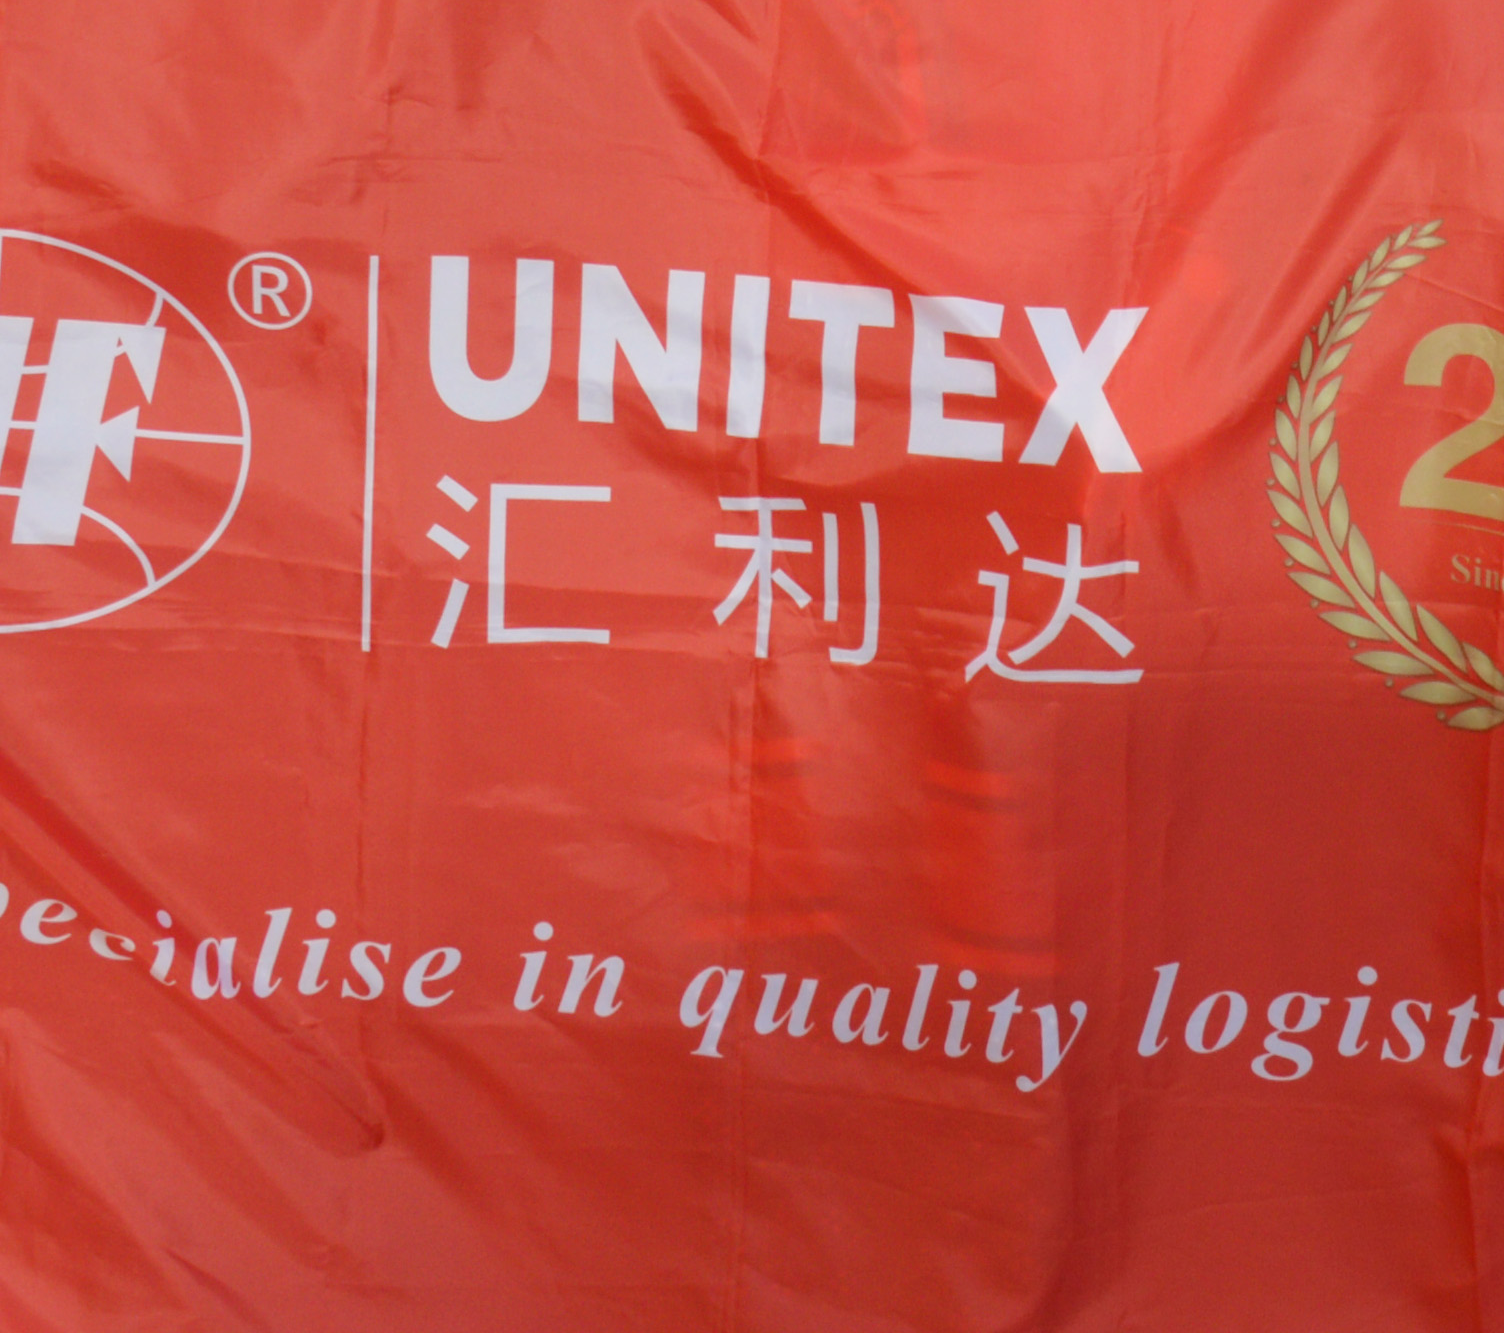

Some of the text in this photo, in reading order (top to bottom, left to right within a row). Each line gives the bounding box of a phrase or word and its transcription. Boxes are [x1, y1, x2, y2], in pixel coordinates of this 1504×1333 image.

[429, 254, 1150, 474] UNITEX
[426, 474, 1145, 685] 汇利达
[512, 920, 627, 1019] in
[678, 962, 1089, 1094] quality
